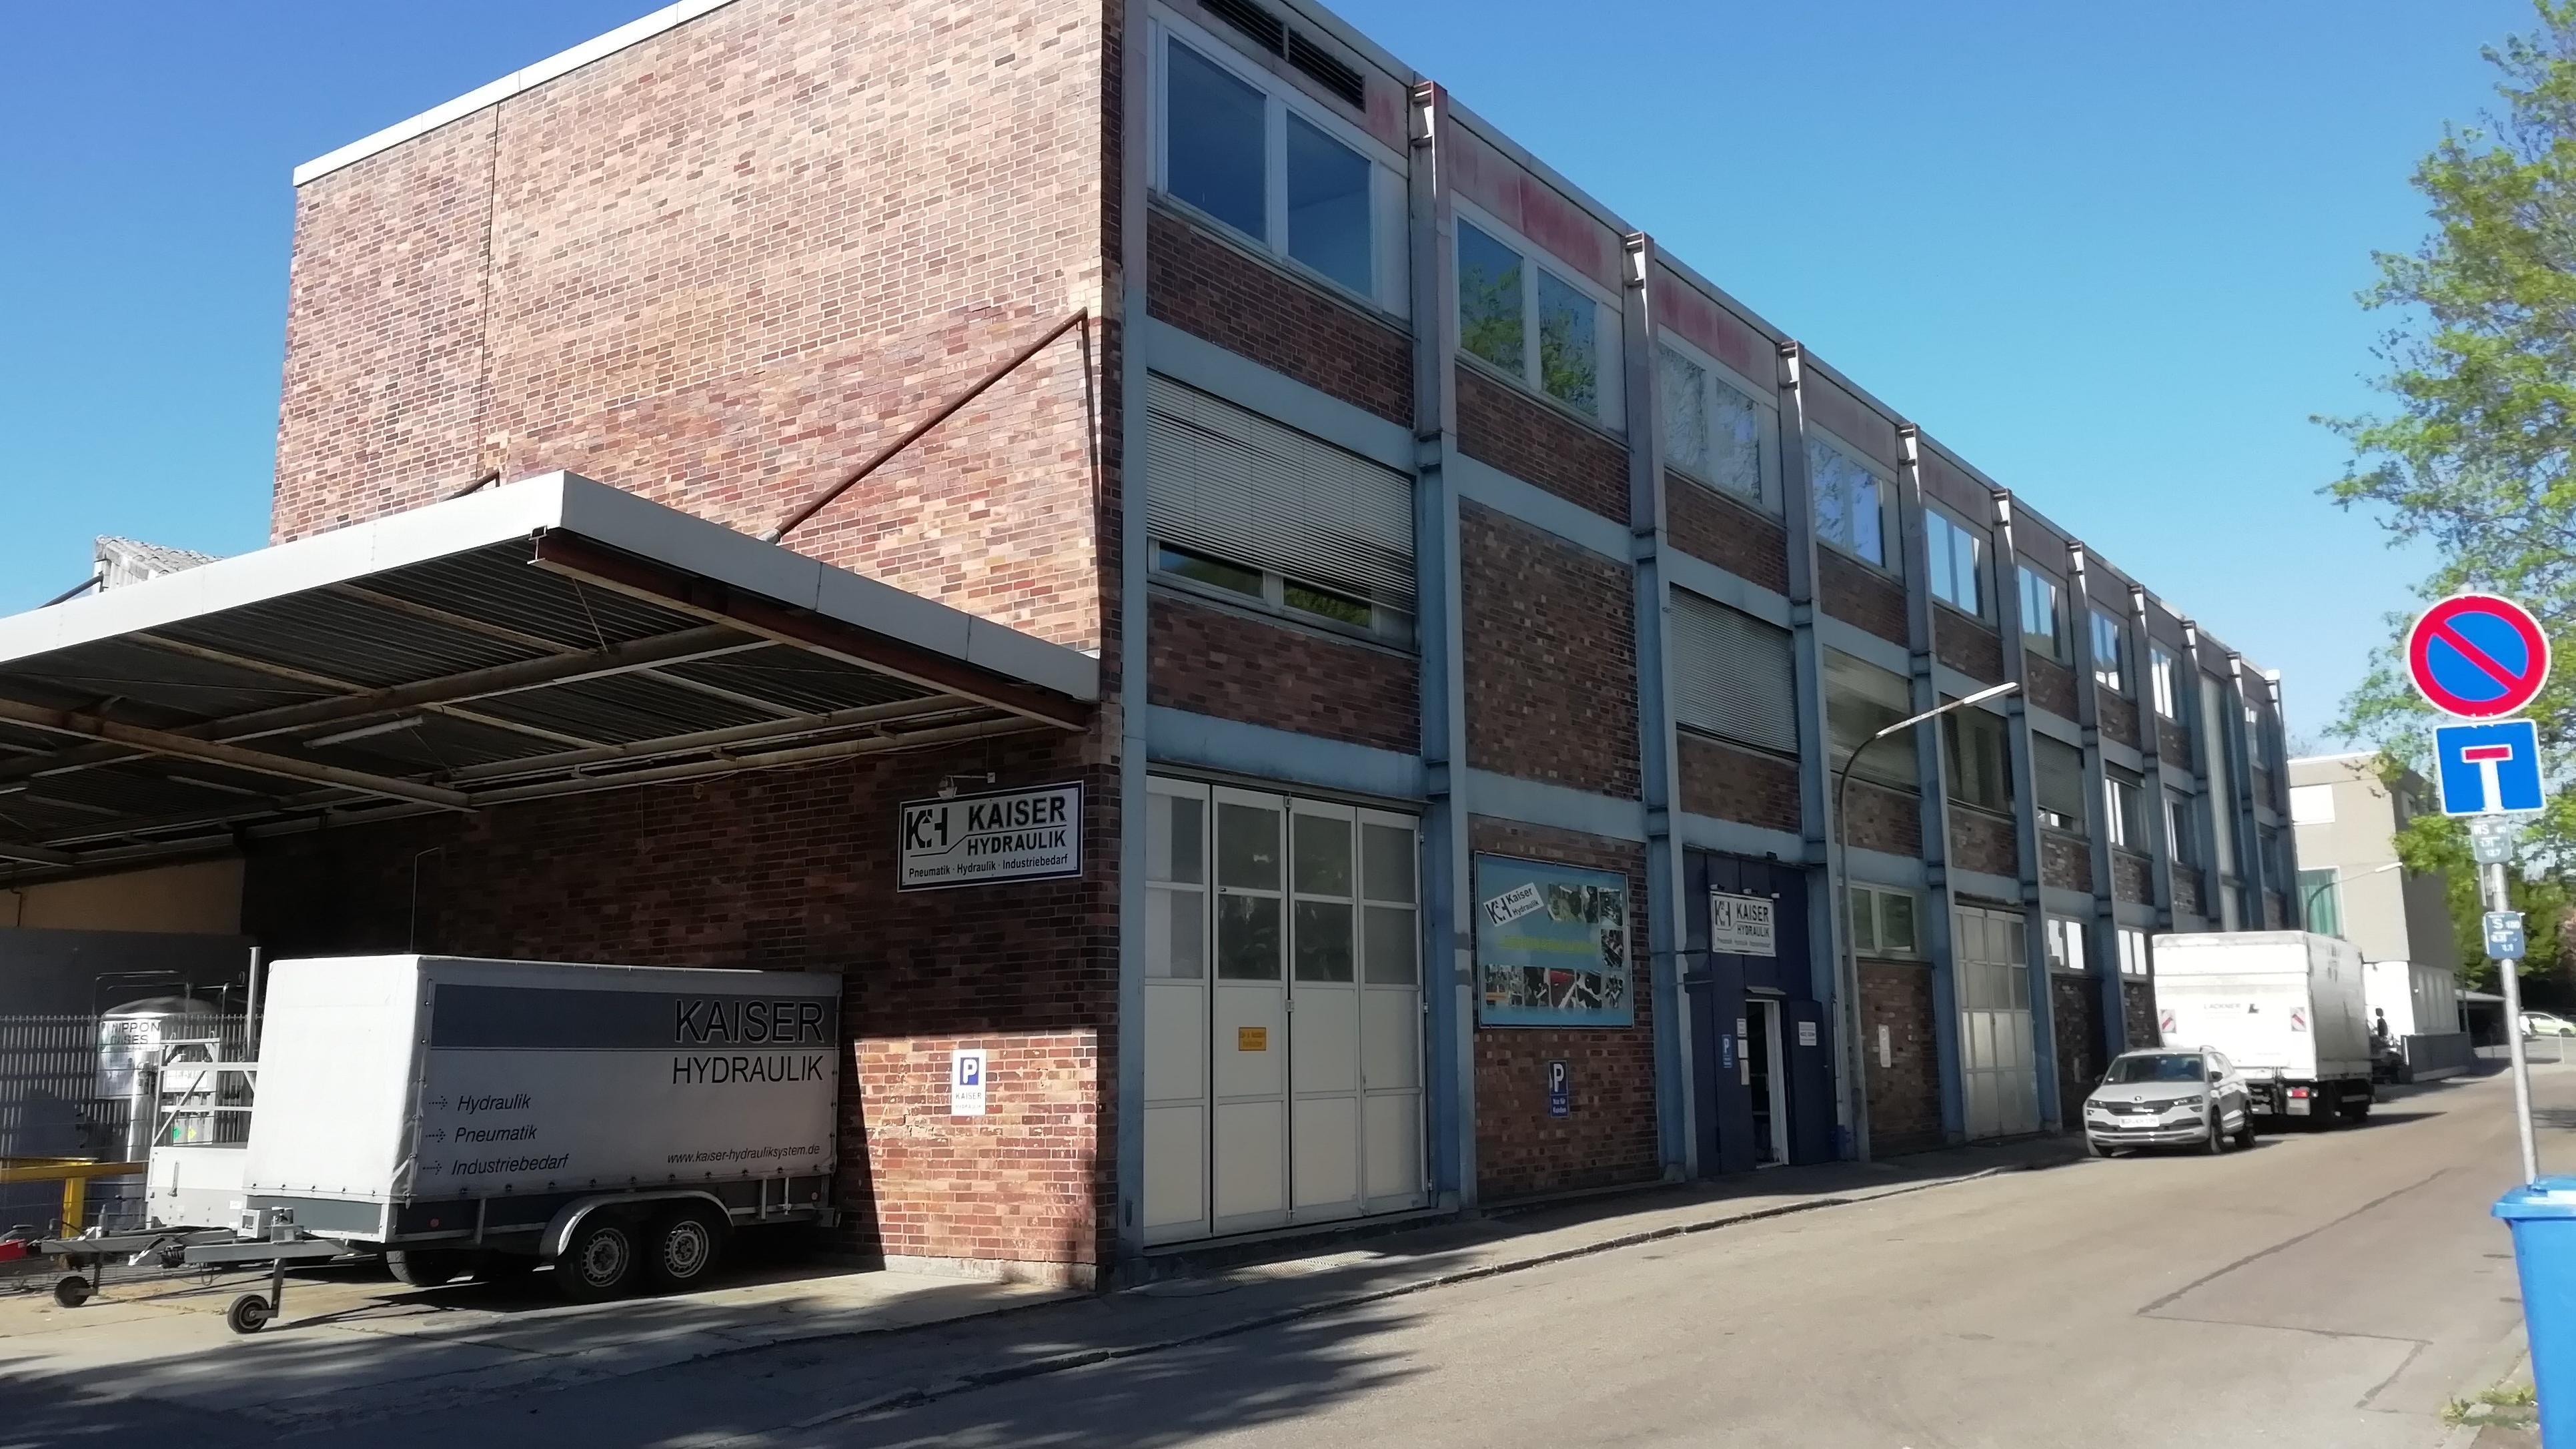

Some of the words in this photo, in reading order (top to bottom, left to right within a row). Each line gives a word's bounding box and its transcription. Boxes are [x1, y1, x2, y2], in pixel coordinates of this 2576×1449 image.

[968, 796, 1067, 832] KAISER
[967, 829, 1067, 857] HYDRAULIK
[909, 865, 950, 879] Pneumatik
[956, 861, 997, 876] Hydraulik
[1003, 854, 1069, 870] Industriebedarf
[1505, 888, 1533, 905] Kaiser
[1512, 899, 1540, 916] Hydraulik
[1736, 903, 1769, 923] KAISER
[1737, 924, 1770, 938] HYDRAULIK
[2492, 918, 2503, 929] S
[112, 1022, 161, 1033] NIPPON
[674, 999, 825, 1044] KAISER
[672, 1055, 824, 1085] HYDRAULIK
[962, 1059, 977, 1084] P
[1553, 1063, 1564, 1093] P
[457, 1093, 532, 1115] Hydraulik
[955, 1092, 982, 1100] KAISER
[454, 1125, 538, 1145] Pneumatik
[667, 1143, 820, 1164] www.kaiser-hydrauliksystem.de
[452, 1153, 569, 1176] Industriebedarf
